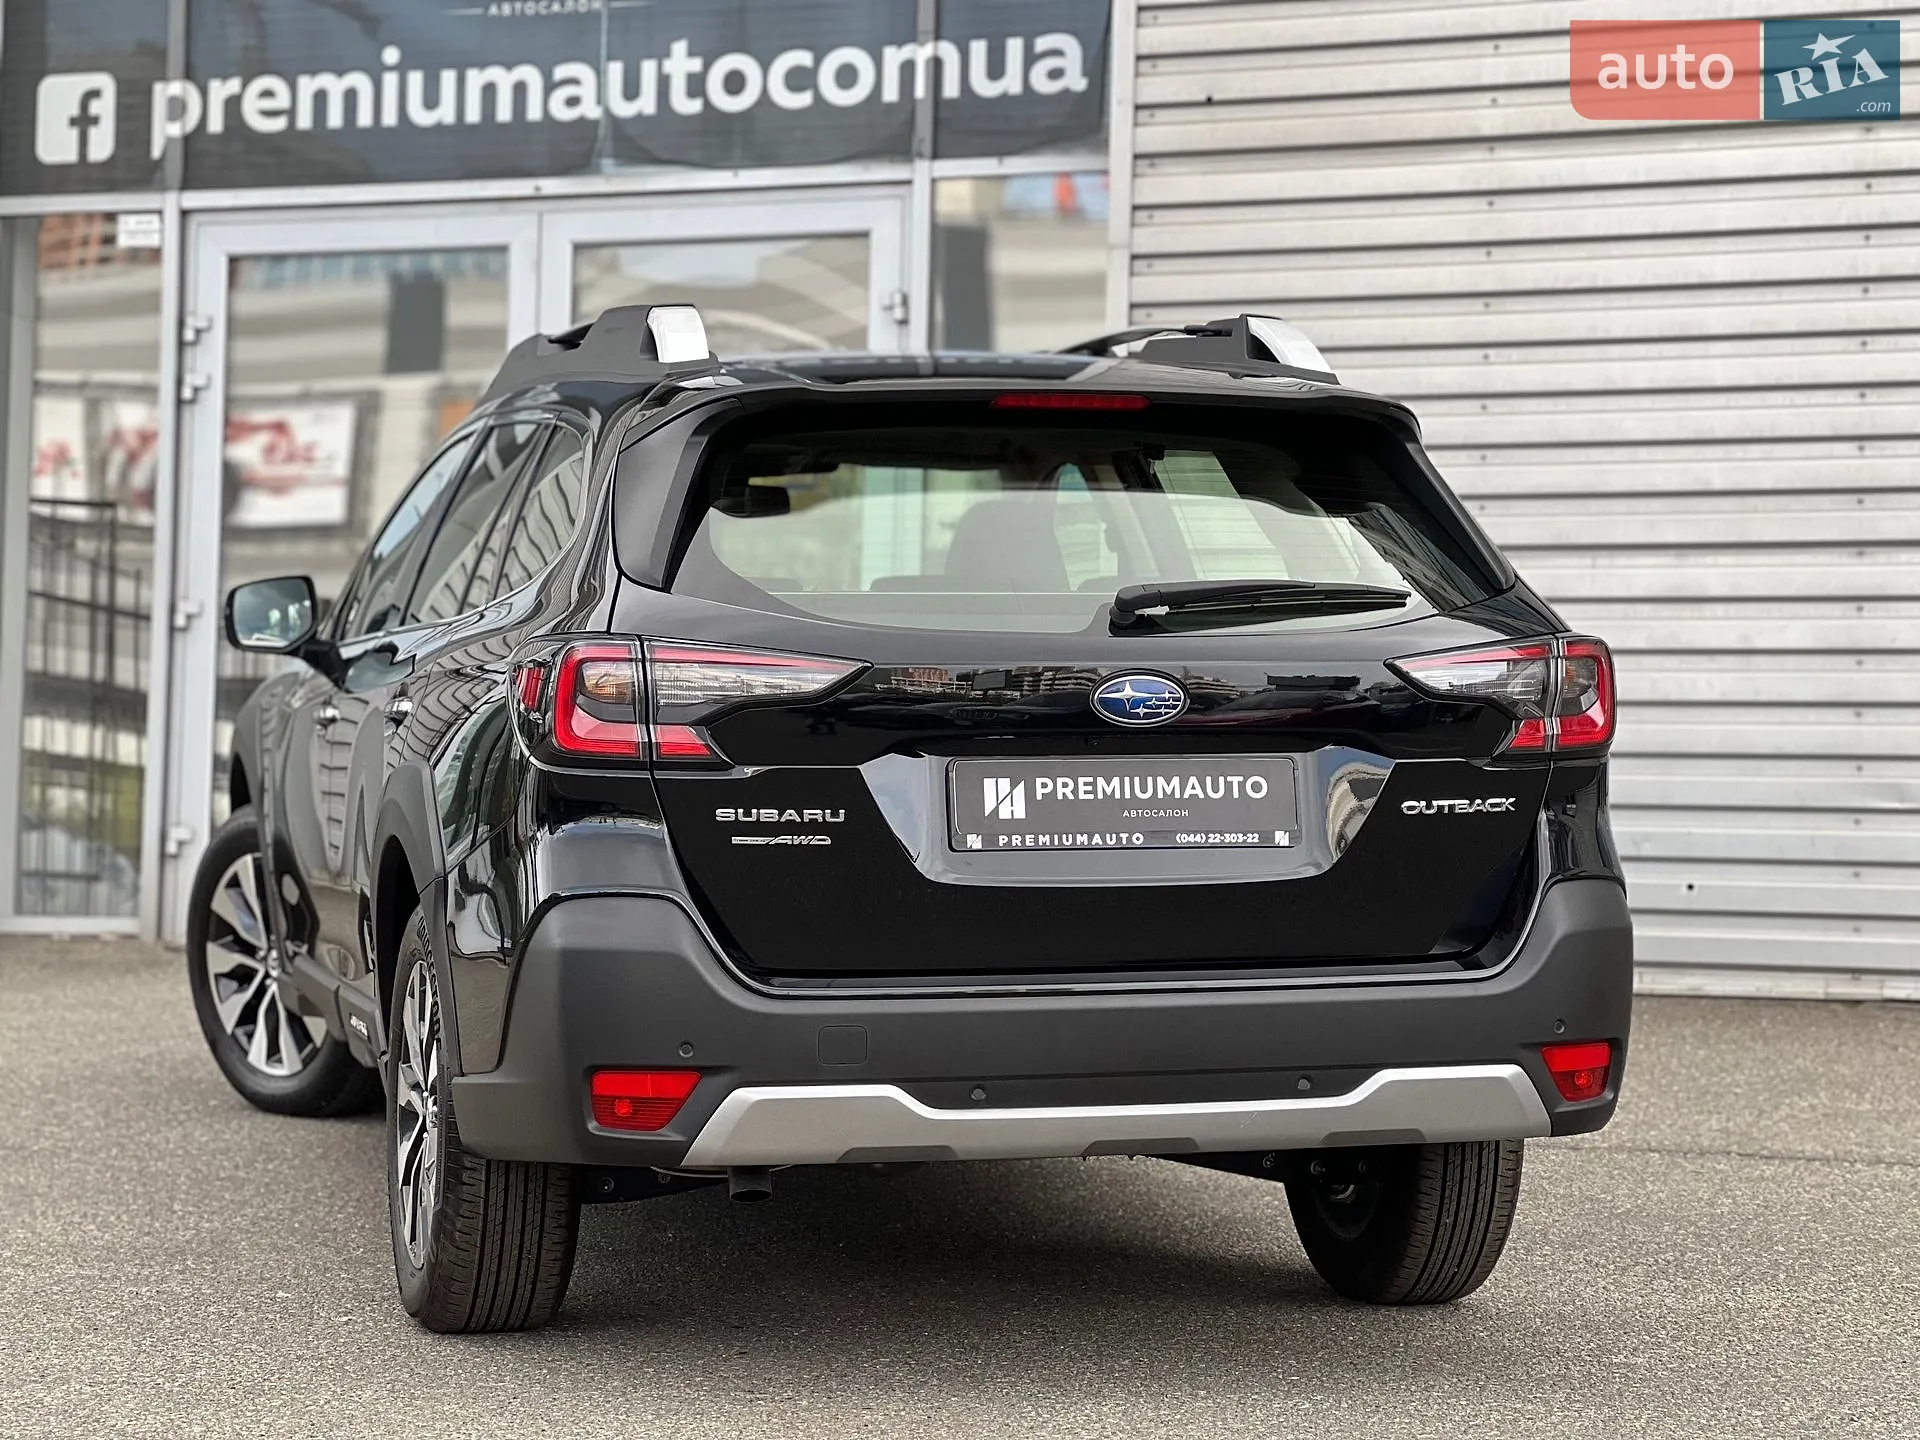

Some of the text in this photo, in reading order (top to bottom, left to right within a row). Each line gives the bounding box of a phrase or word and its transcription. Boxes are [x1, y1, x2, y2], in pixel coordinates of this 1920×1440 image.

[487, 0, 602, 17] АВТОСАЛОН
[150, 32, 1089, 160] premiumautocomua
[1035, 775, 1269, 801] PREMIUMAUTO
[1122, 808, 1190, 818] АВТОСАЛОН
[1400, 797, 1516, 815] OUTBACK
[715, 808, 846, 823] SUBARU
[768, 835, 832, 845] AWD
[998, 831, 1260, 847] PREMIUMAUTO (044) 22-303-22
